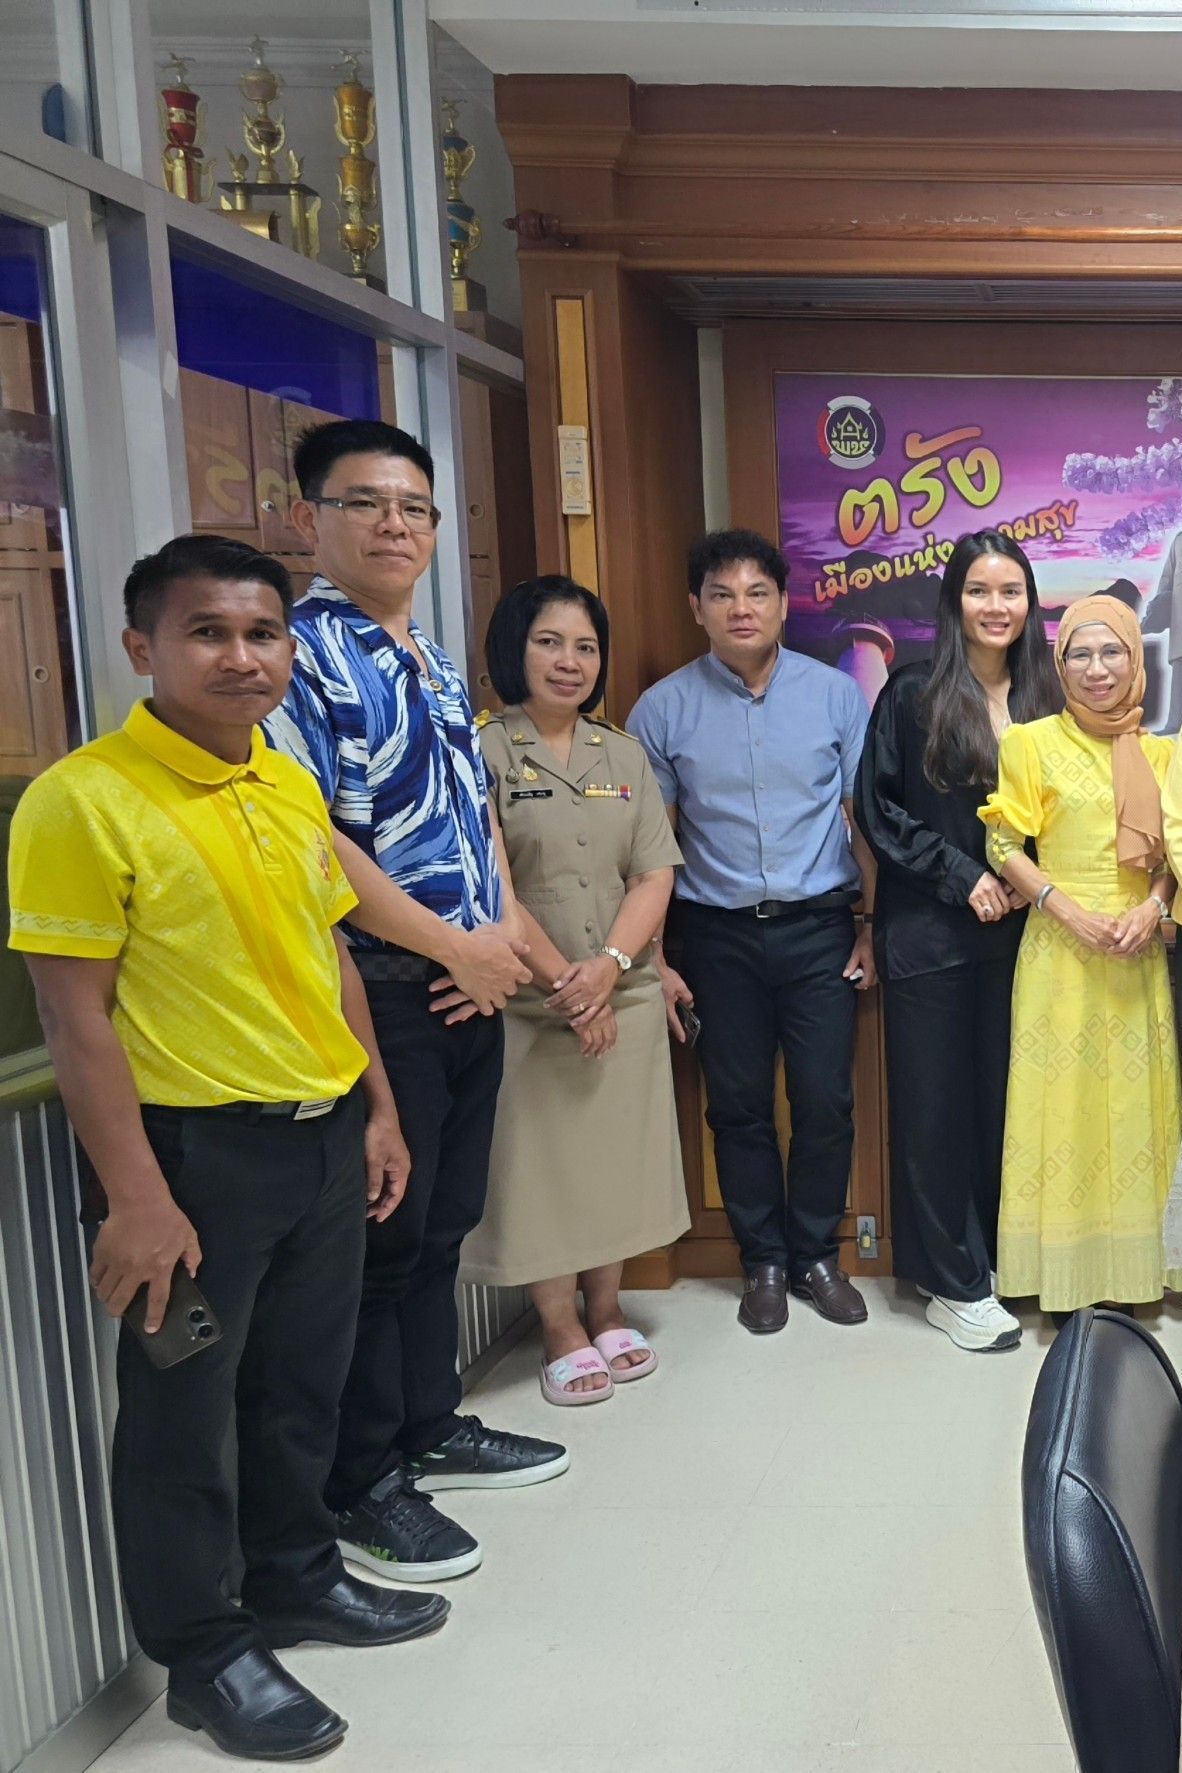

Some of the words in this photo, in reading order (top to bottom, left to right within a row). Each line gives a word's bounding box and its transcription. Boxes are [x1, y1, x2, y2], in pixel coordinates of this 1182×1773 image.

[838, 426, 1001, 546] ตรัง
[815, 500, 1078, 602] เมืองแห่งามสุข
